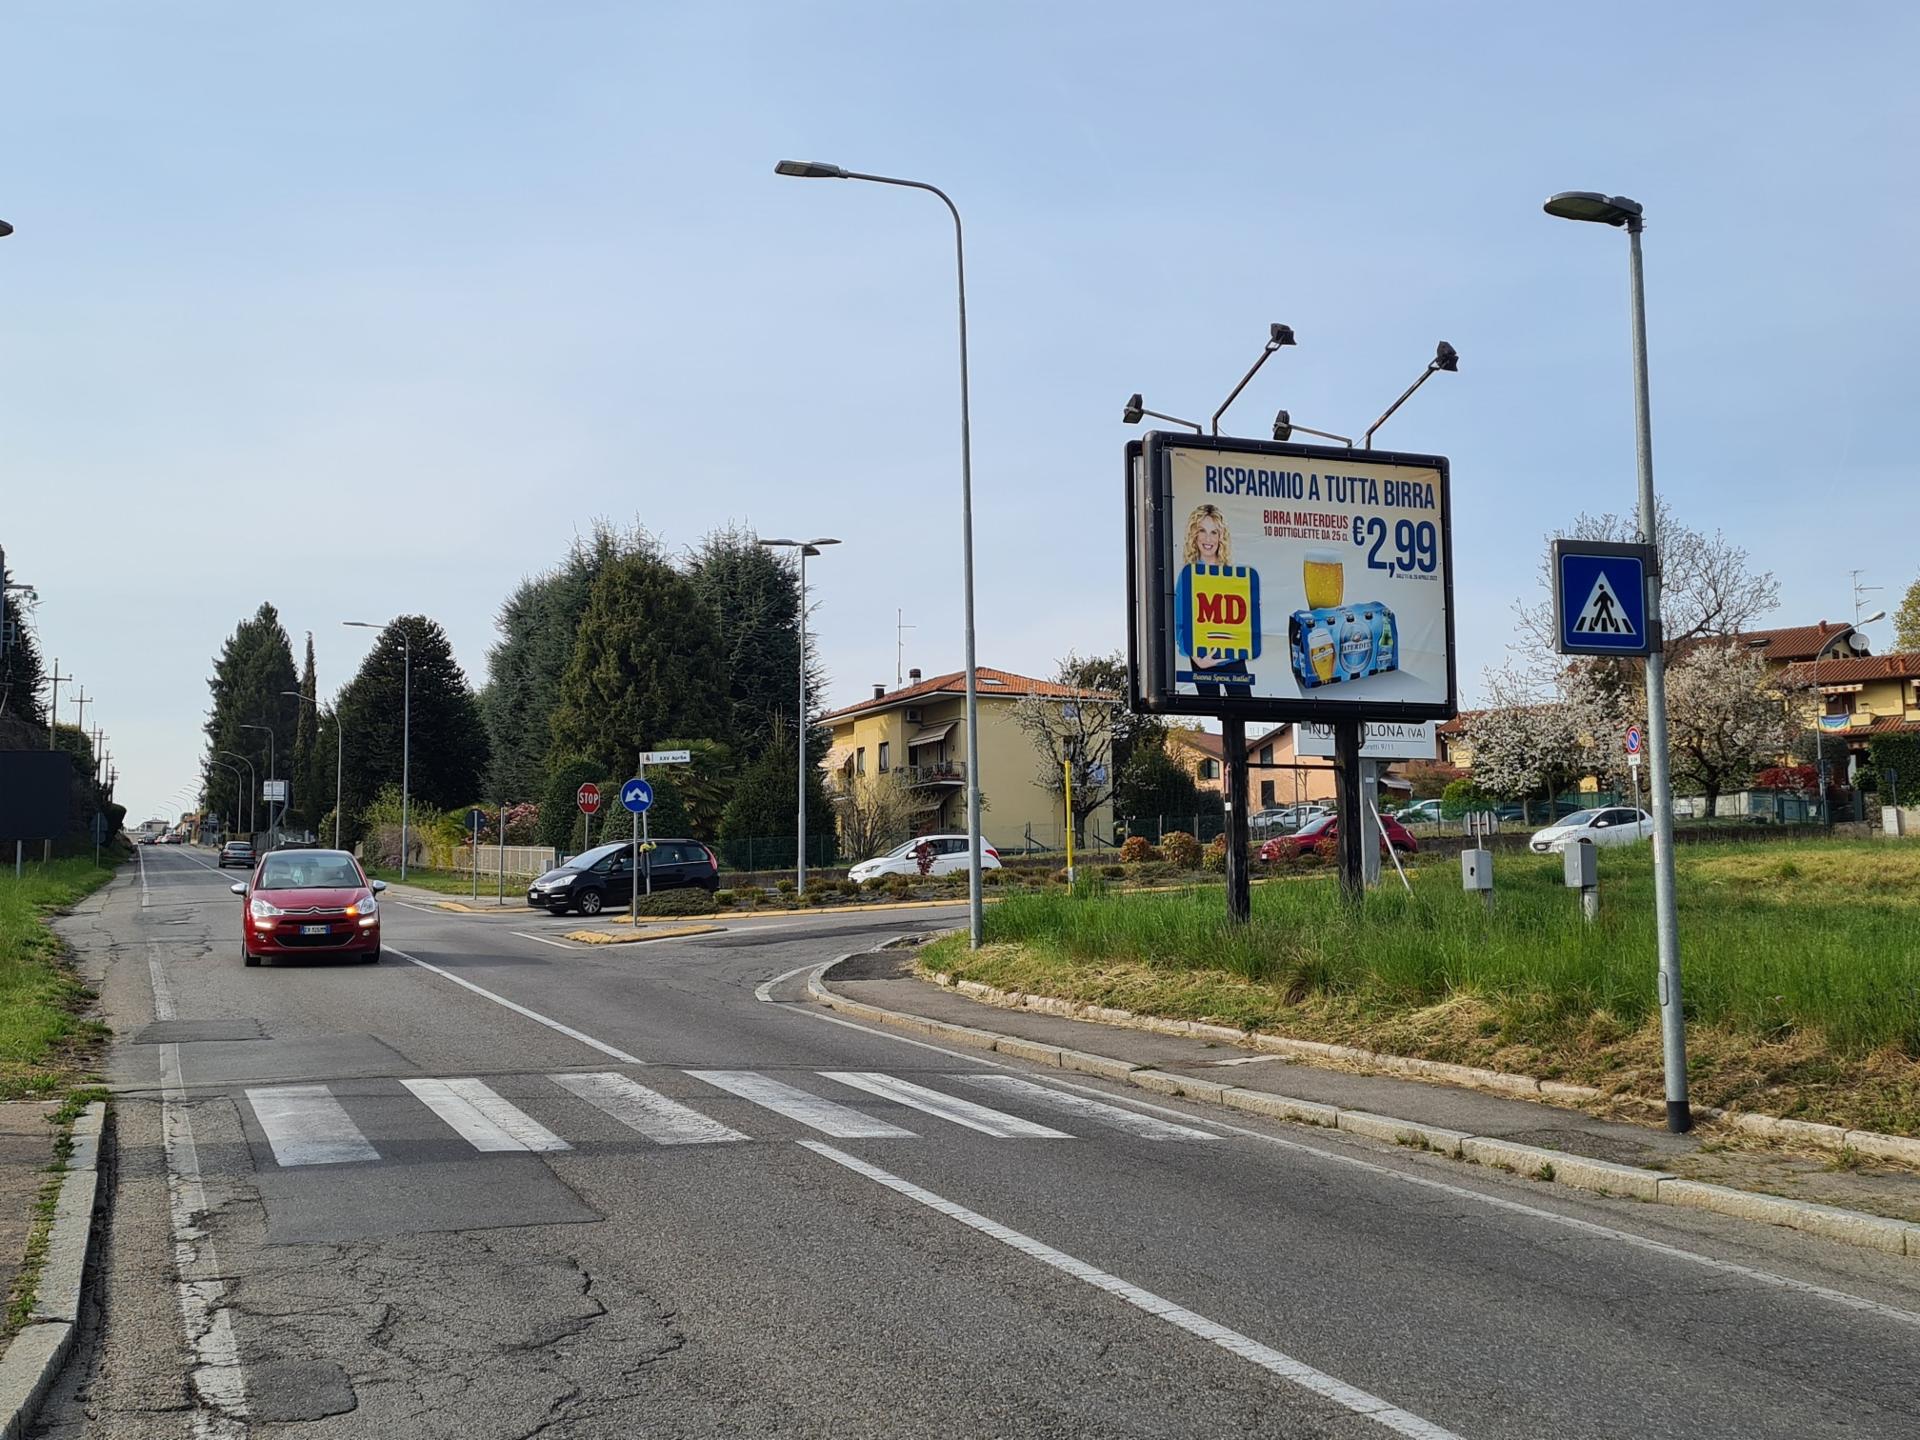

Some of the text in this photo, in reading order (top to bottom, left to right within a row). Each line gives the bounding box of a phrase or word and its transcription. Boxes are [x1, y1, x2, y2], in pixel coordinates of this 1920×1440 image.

[1205, 465, 1436, 509] RISPARMIO A TUTTA BIRRA
[1263, 509, 1349, 530] BIRRA MATERDEUS
[1263, 526, 1272, 537] 10
[1274, 526, 1319, 540] BOTTIGLIETTE
[1321, 530, 1331, 540] DA
[1332, 530, 1341, 541] 25
[1196, 592, 1247, 624] MD
[1407, 728, 1426, 738] (VA)
[580, 792, 599, 805] STOP
